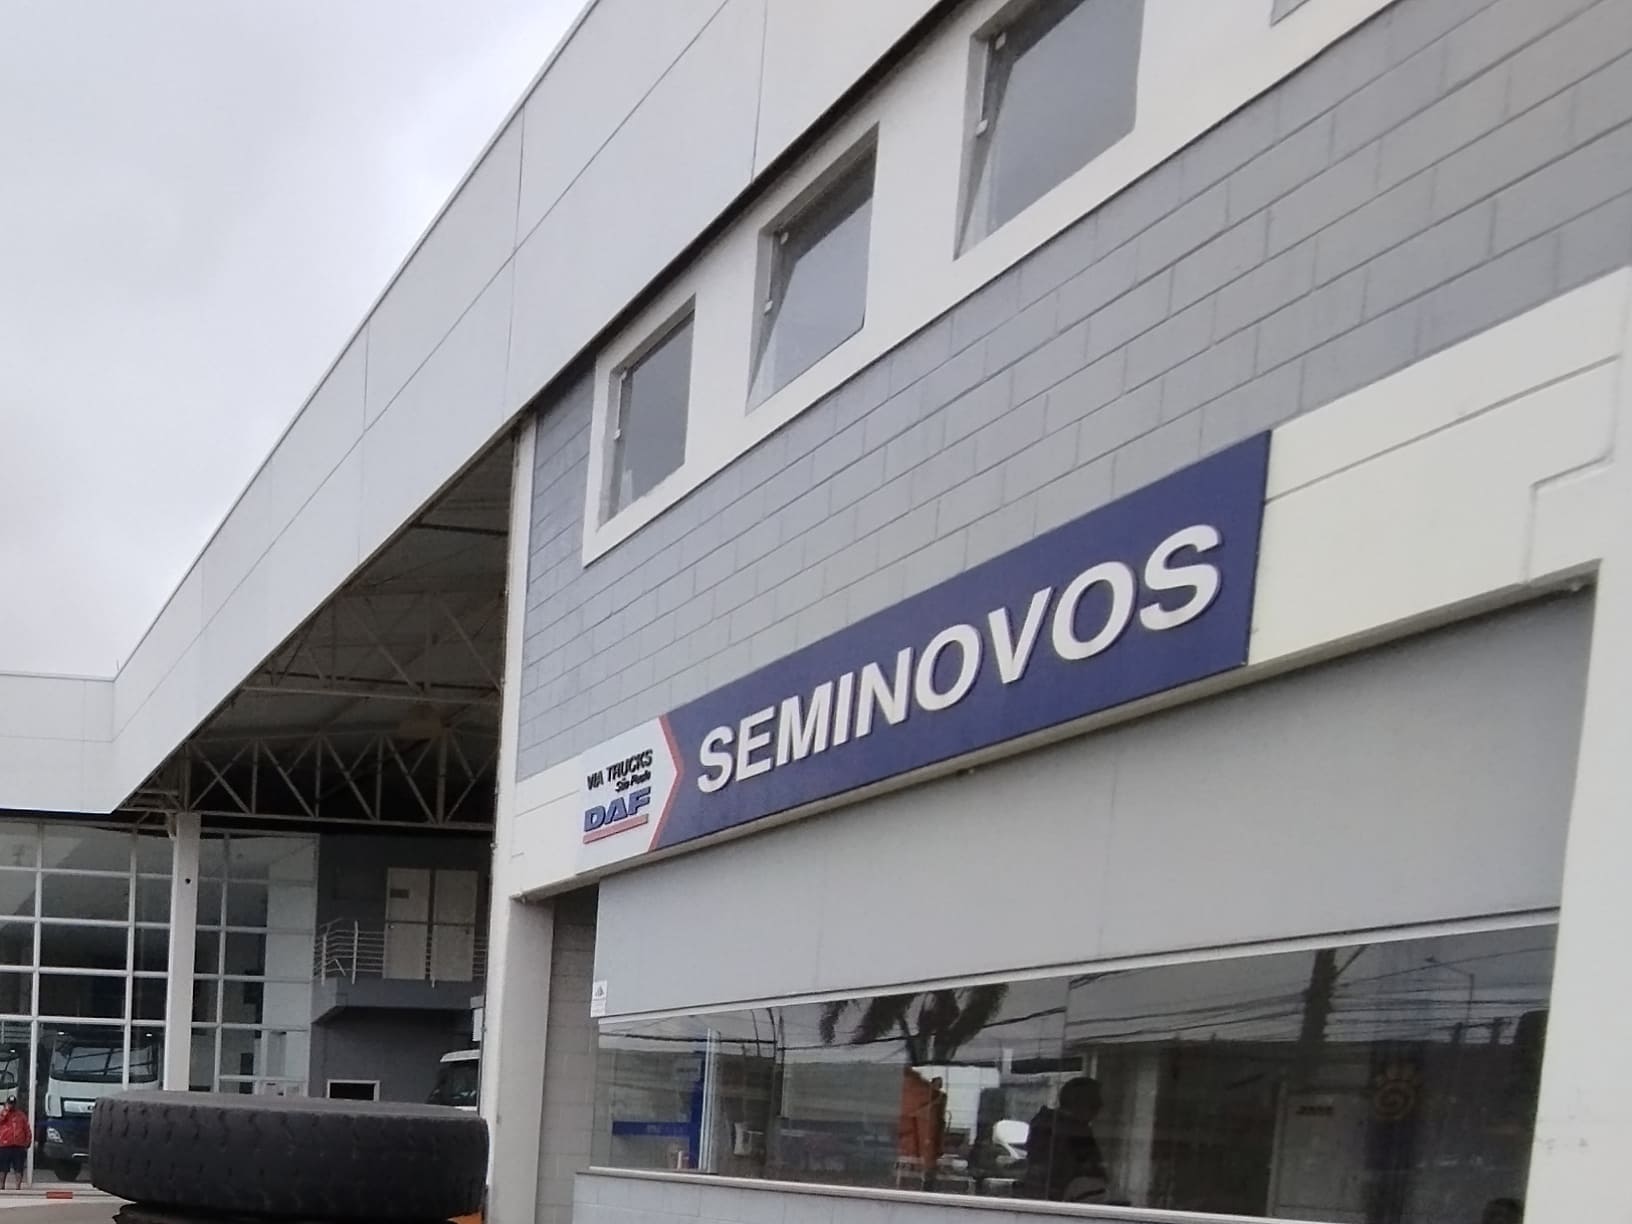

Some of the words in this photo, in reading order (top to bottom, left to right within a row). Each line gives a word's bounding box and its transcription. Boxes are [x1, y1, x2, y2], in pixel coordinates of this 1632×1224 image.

[697, 524, 1222, 793] SEMINOVOS
[587, 770, 604, 790] VIA
[606, 749, 653, 782] TRUCKS
[584, 786, 651, 832] DAF
